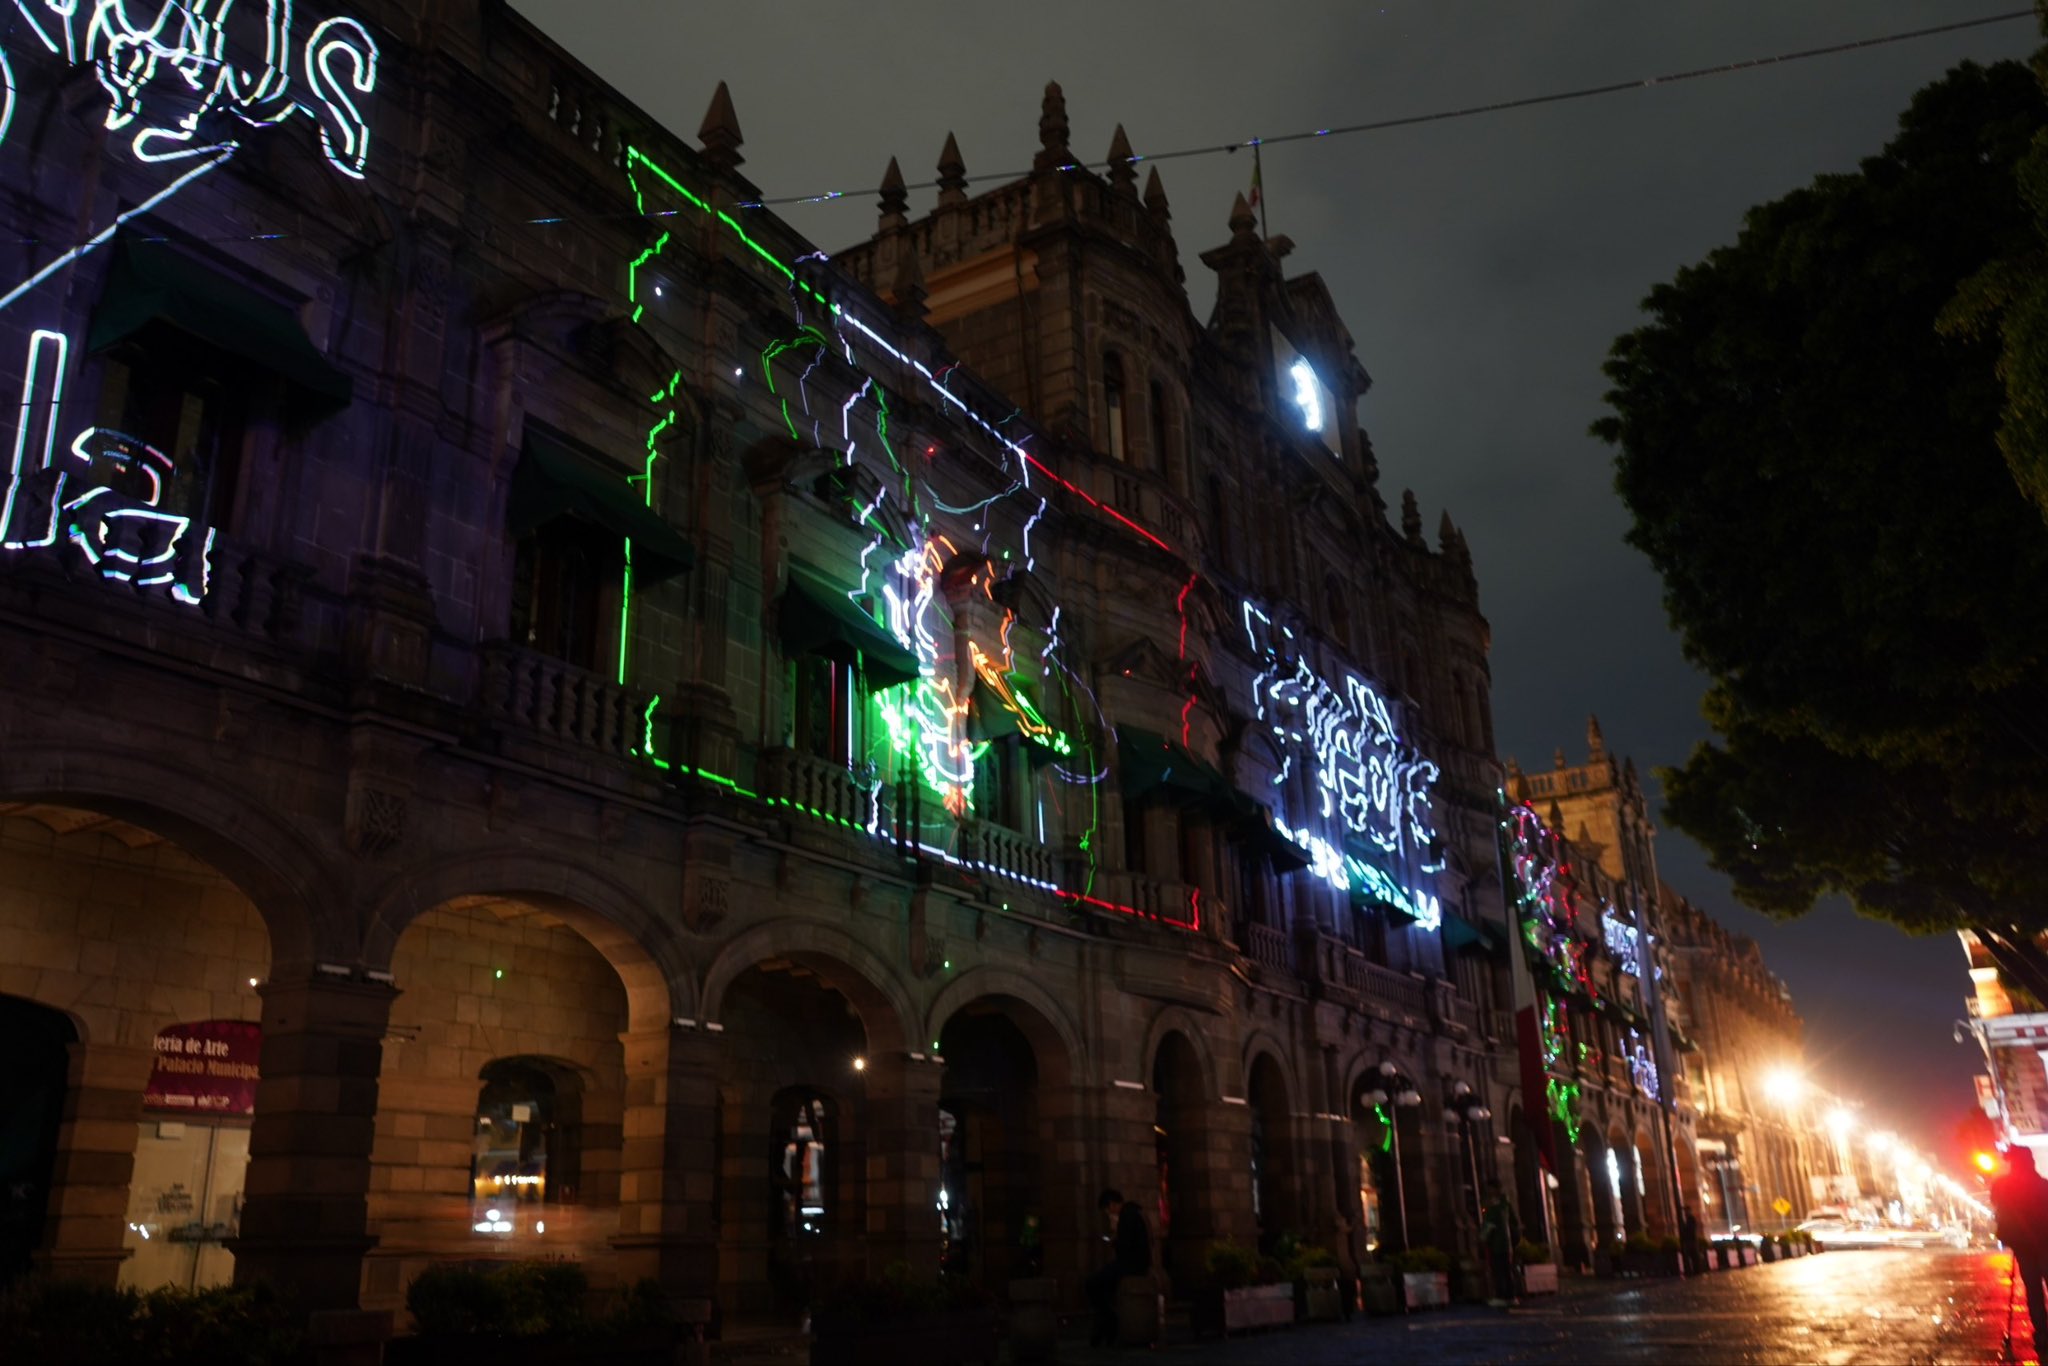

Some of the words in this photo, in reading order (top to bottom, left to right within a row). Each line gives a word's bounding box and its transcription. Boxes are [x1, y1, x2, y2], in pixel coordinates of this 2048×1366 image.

[185, 1037, 202, 1055] de
[203, 1038, 229, 1057] Arte
[157, 1056, 205, 1075] Palacio
[206, 1059, 260, 1080] Municipa
